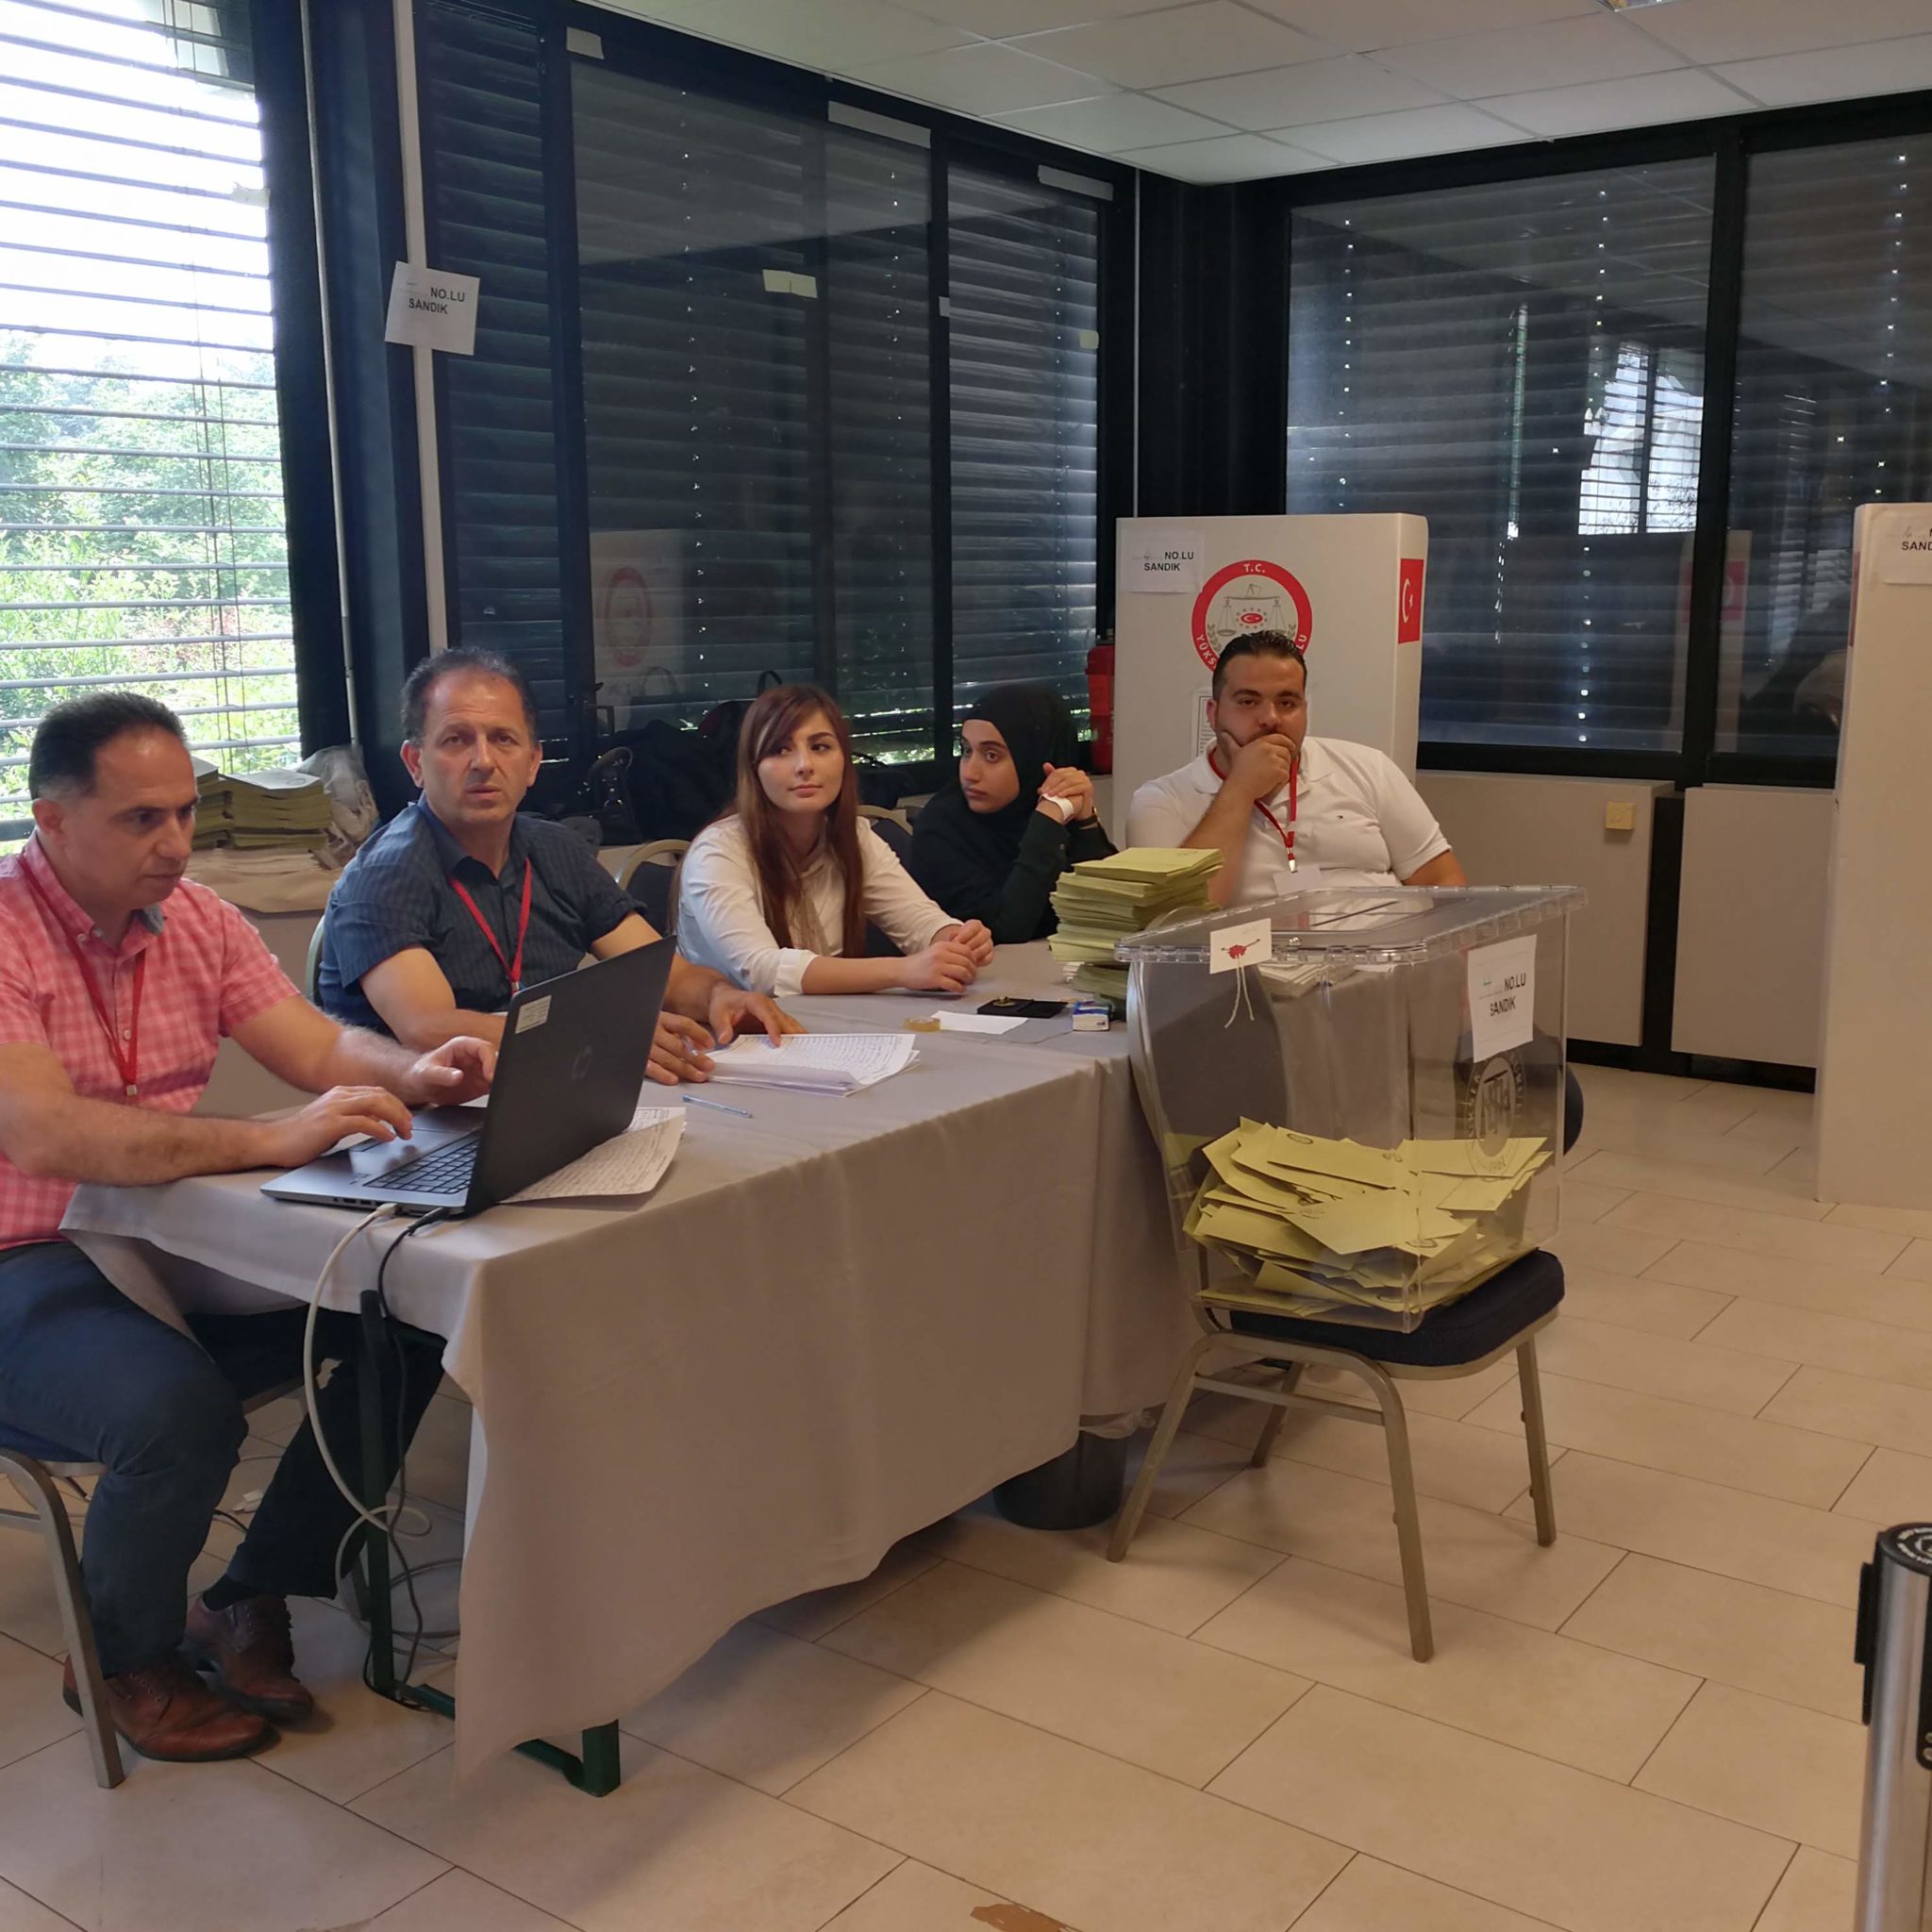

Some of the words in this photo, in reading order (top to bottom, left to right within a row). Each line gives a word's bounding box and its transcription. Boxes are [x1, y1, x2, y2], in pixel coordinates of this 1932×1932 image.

[430, 287, 465, 302] NO.LU
[408, 298, 448, 314] SANDIK
[1164, 551, 1194, 559] NO.LU
[1143, 562, 1180, 572] SANDIK
[1243, 563, 1266, 574] T.C.
[1504, 973, 1526, 991] NO.LU
[1490, 995, 1516, 1017] SANDIK
